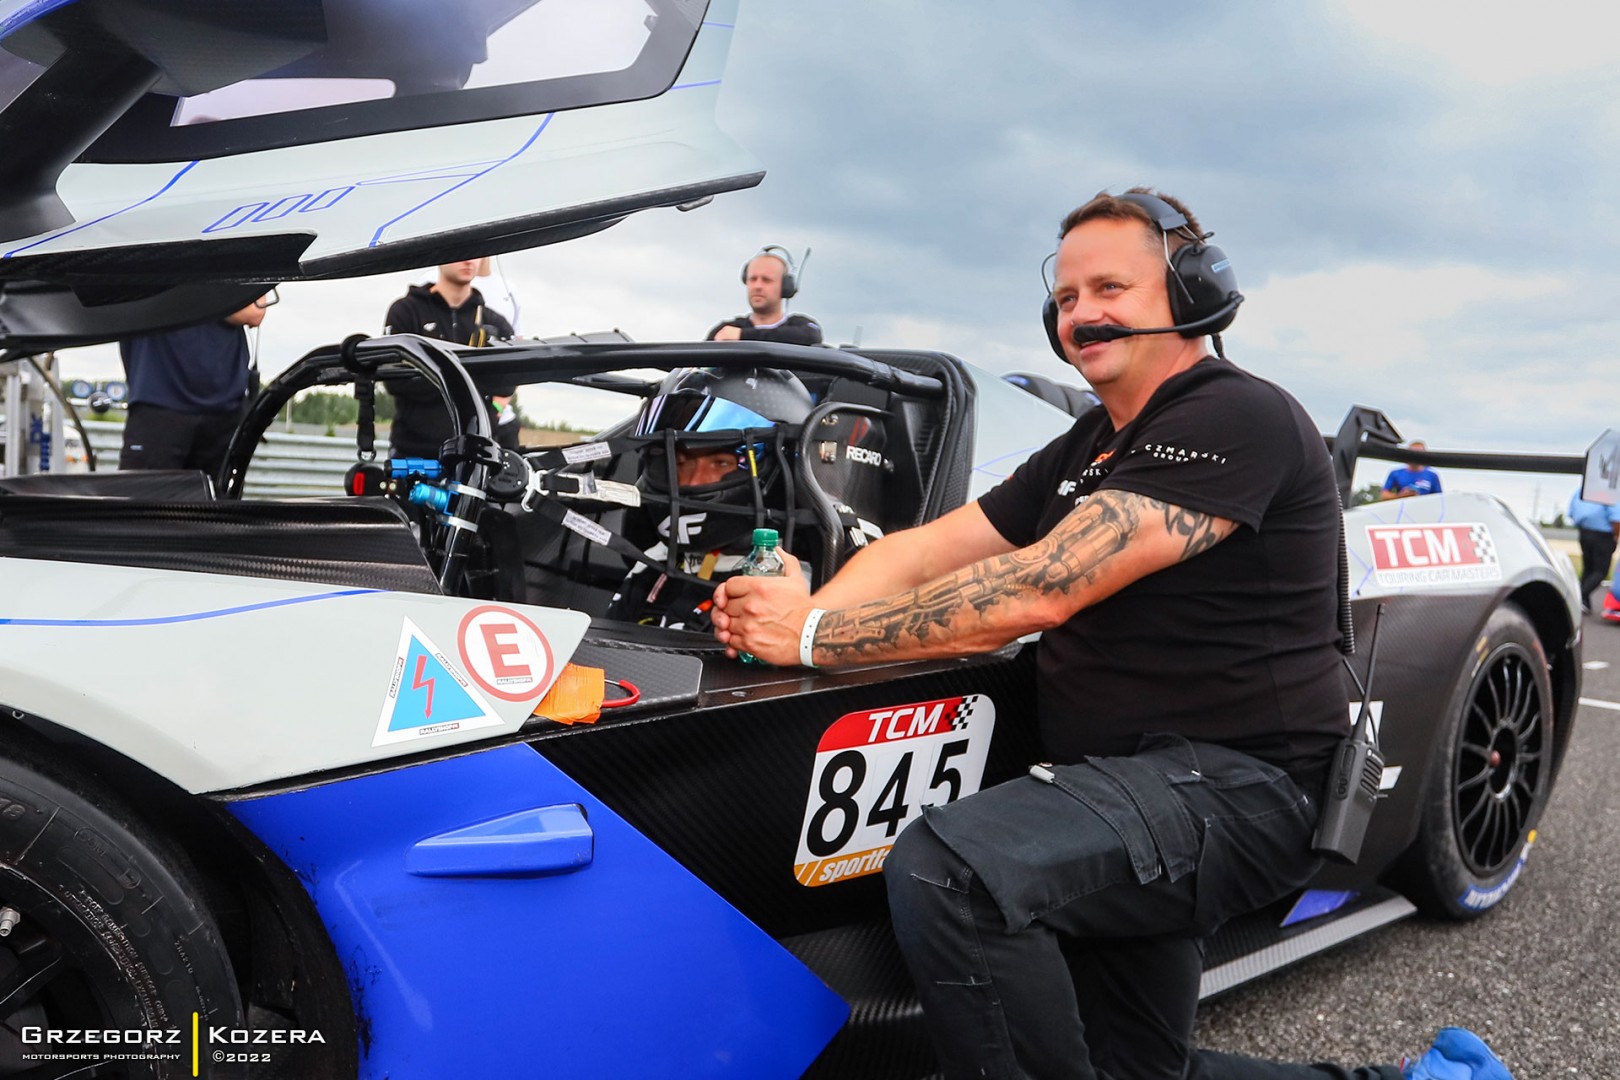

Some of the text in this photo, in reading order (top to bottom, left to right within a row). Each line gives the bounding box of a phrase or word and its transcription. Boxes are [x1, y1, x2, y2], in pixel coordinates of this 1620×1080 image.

[845, 445, 882, 467] RECARO
[1131, 444, 1227, 465] CZMARSKI
[1374, 528, 1462, 567] TCM
[1378, 566, 1500, 585] TOURING CAR MASTERS
[479, 623, 532, 678] E
[868, 703, 945, 743] TCM
[806, 738, 970, 857] 845
